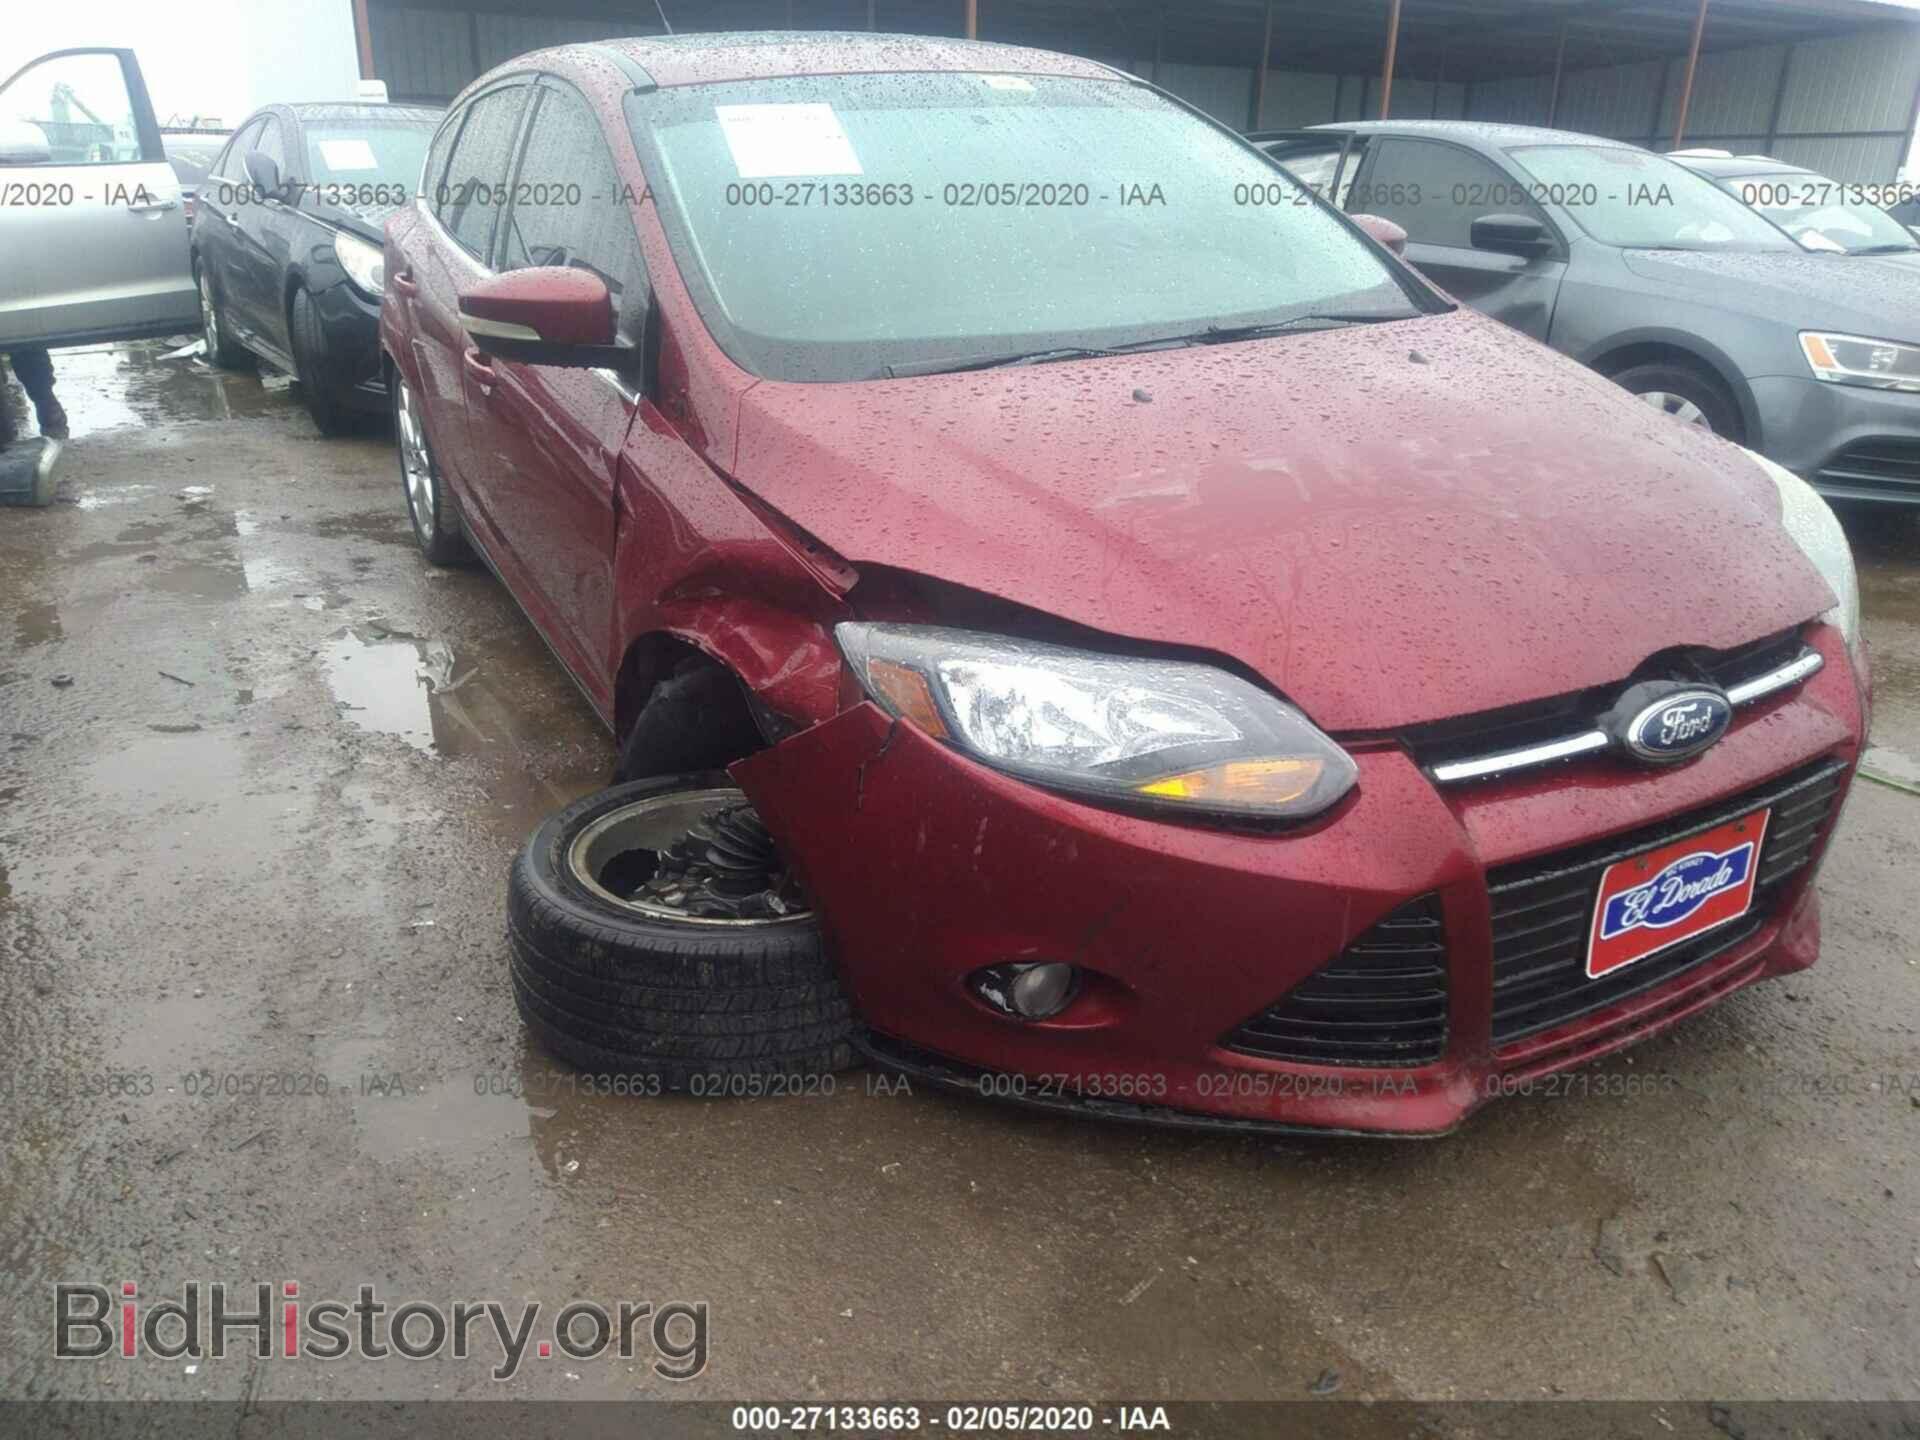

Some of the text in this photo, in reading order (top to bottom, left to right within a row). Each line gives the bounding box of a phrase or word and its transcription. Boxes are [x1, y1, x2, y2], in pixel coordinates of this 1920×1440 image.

[1660, 702, 1713, 745] Ford
[1621, 886, 1657, 927] El
[1653, 858, 1734, 915] Dorado
